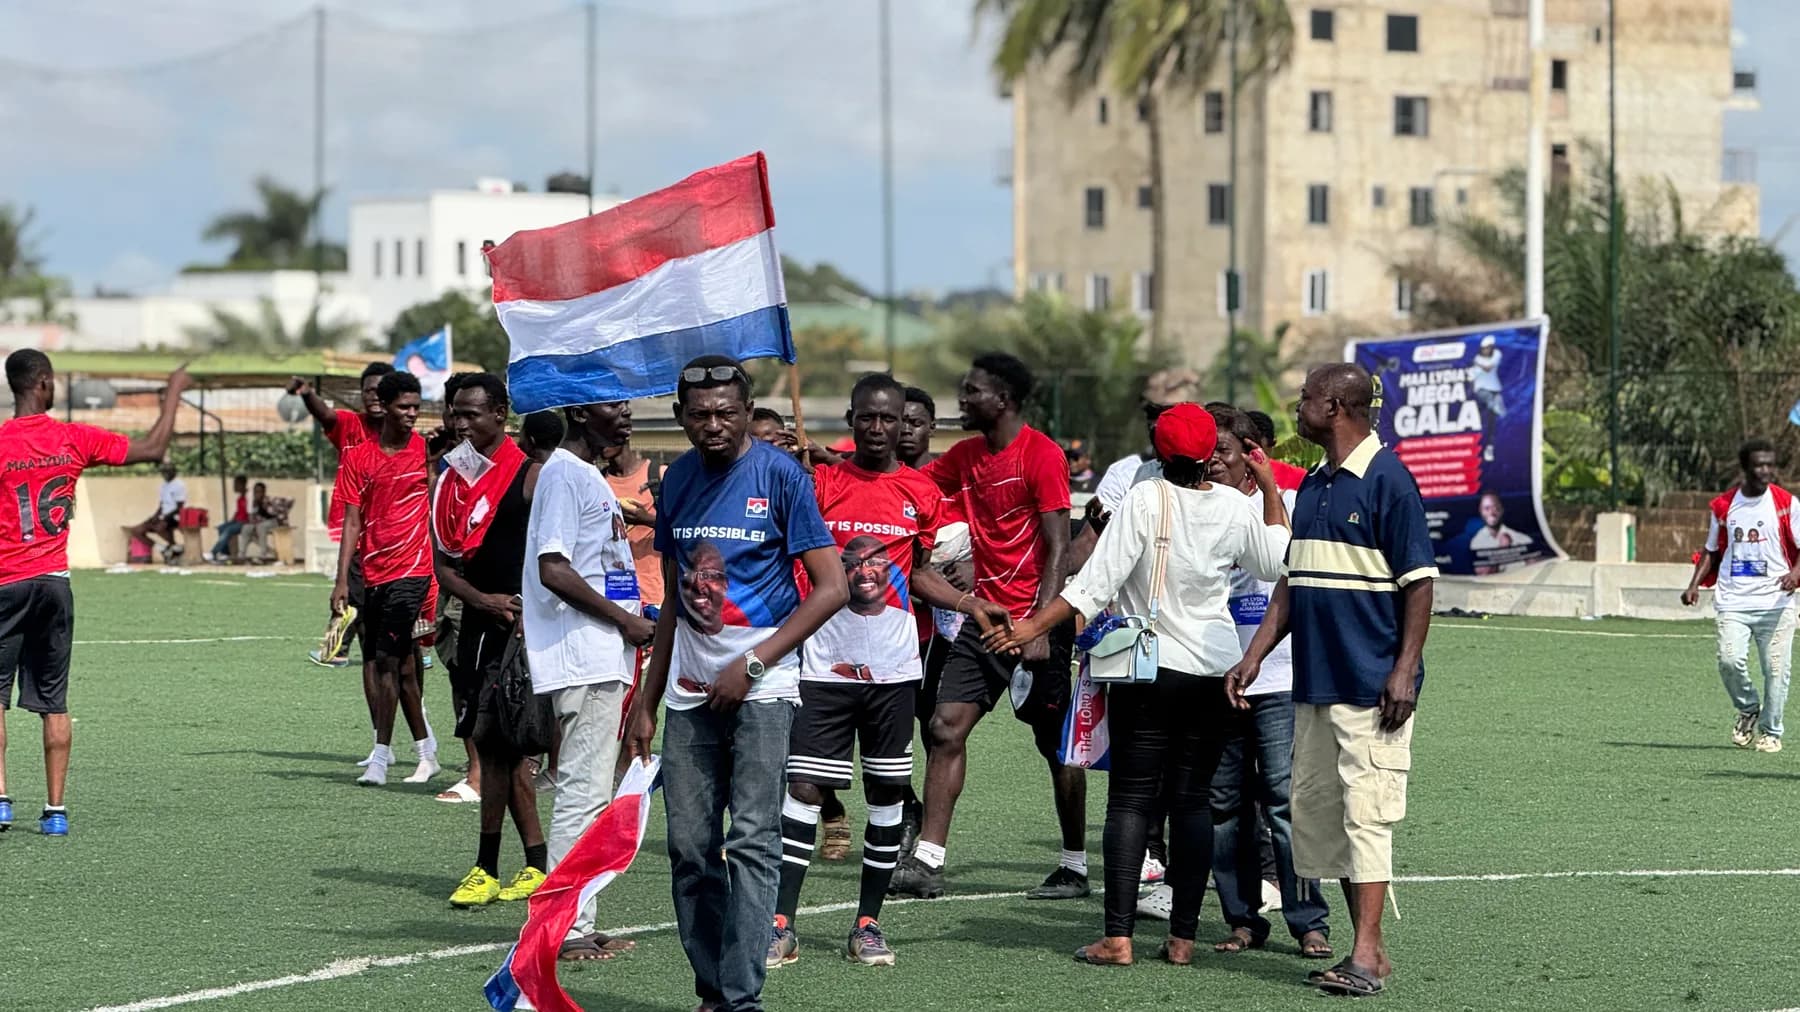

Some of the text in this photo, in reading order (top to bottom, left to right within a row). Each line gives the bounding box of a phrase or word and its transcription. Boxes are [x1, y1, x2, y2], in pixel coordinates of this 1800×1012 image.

[1399, 373, 1427, 388] MAA
[1407, 383, 1467, 406] MEGA
[1394, 400, 1482, 437] GALA
[7, 454, 73, 471] MAA LYDIA
[15, 474, 73, 542] 16
[672, 525, 766, 542] IT IS POSSIBLE!
[838, 520, 852, 531] IS
[1080, 679, 1093, 726] LORD'S
[1080, 730, 1093, 754] THE
